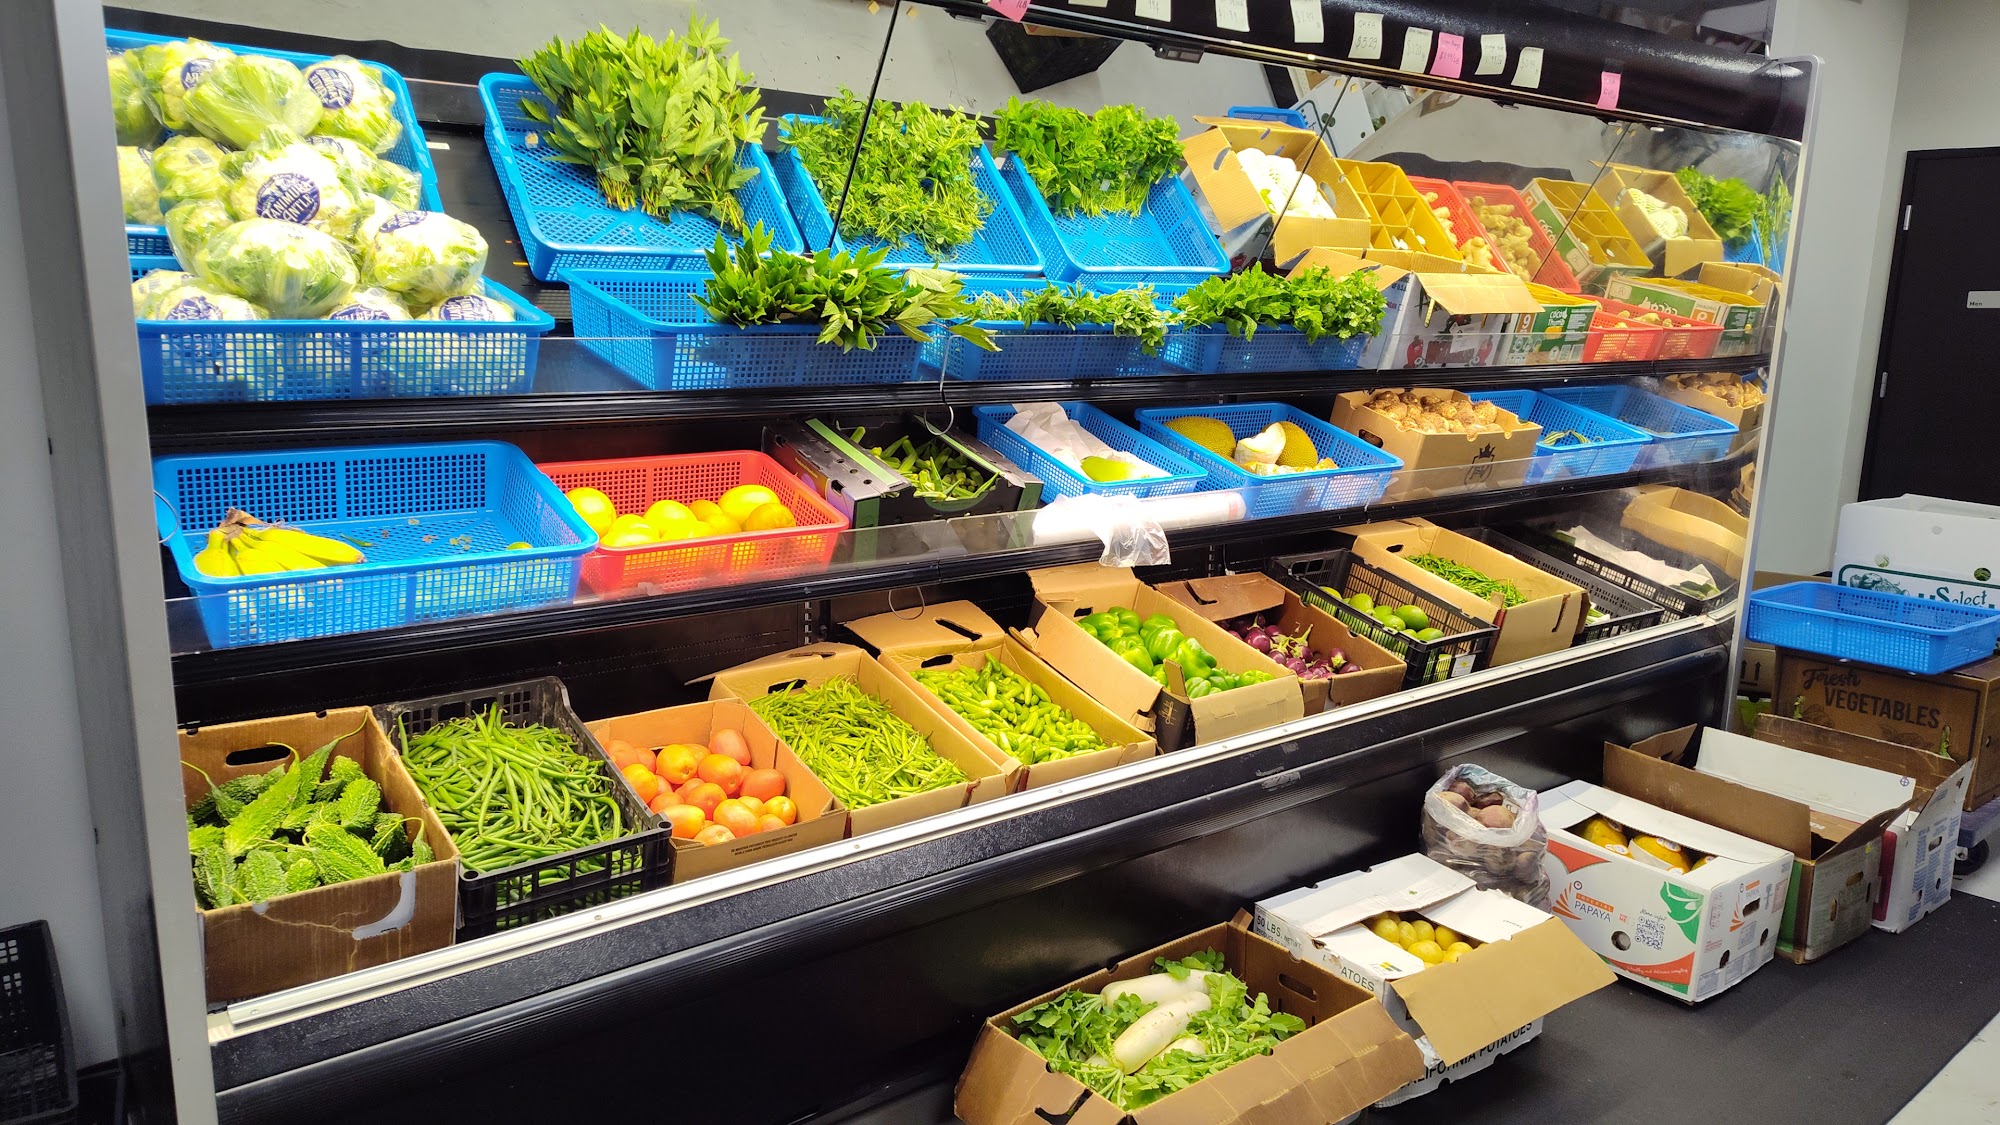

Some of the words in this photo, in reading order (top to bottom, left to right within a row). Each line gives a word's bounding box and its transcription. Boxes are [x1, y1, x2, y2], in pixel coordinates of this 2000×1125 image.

[1802, 667, 1861, 691] Fresh
[1824, 687, 1941, 729] VEGETABLES
[1574, 900, 1612, 922] PAPAYA
[1576, 894, 1613, 912] IMPERIAL
[1256, 915, 1266, 927] 50
